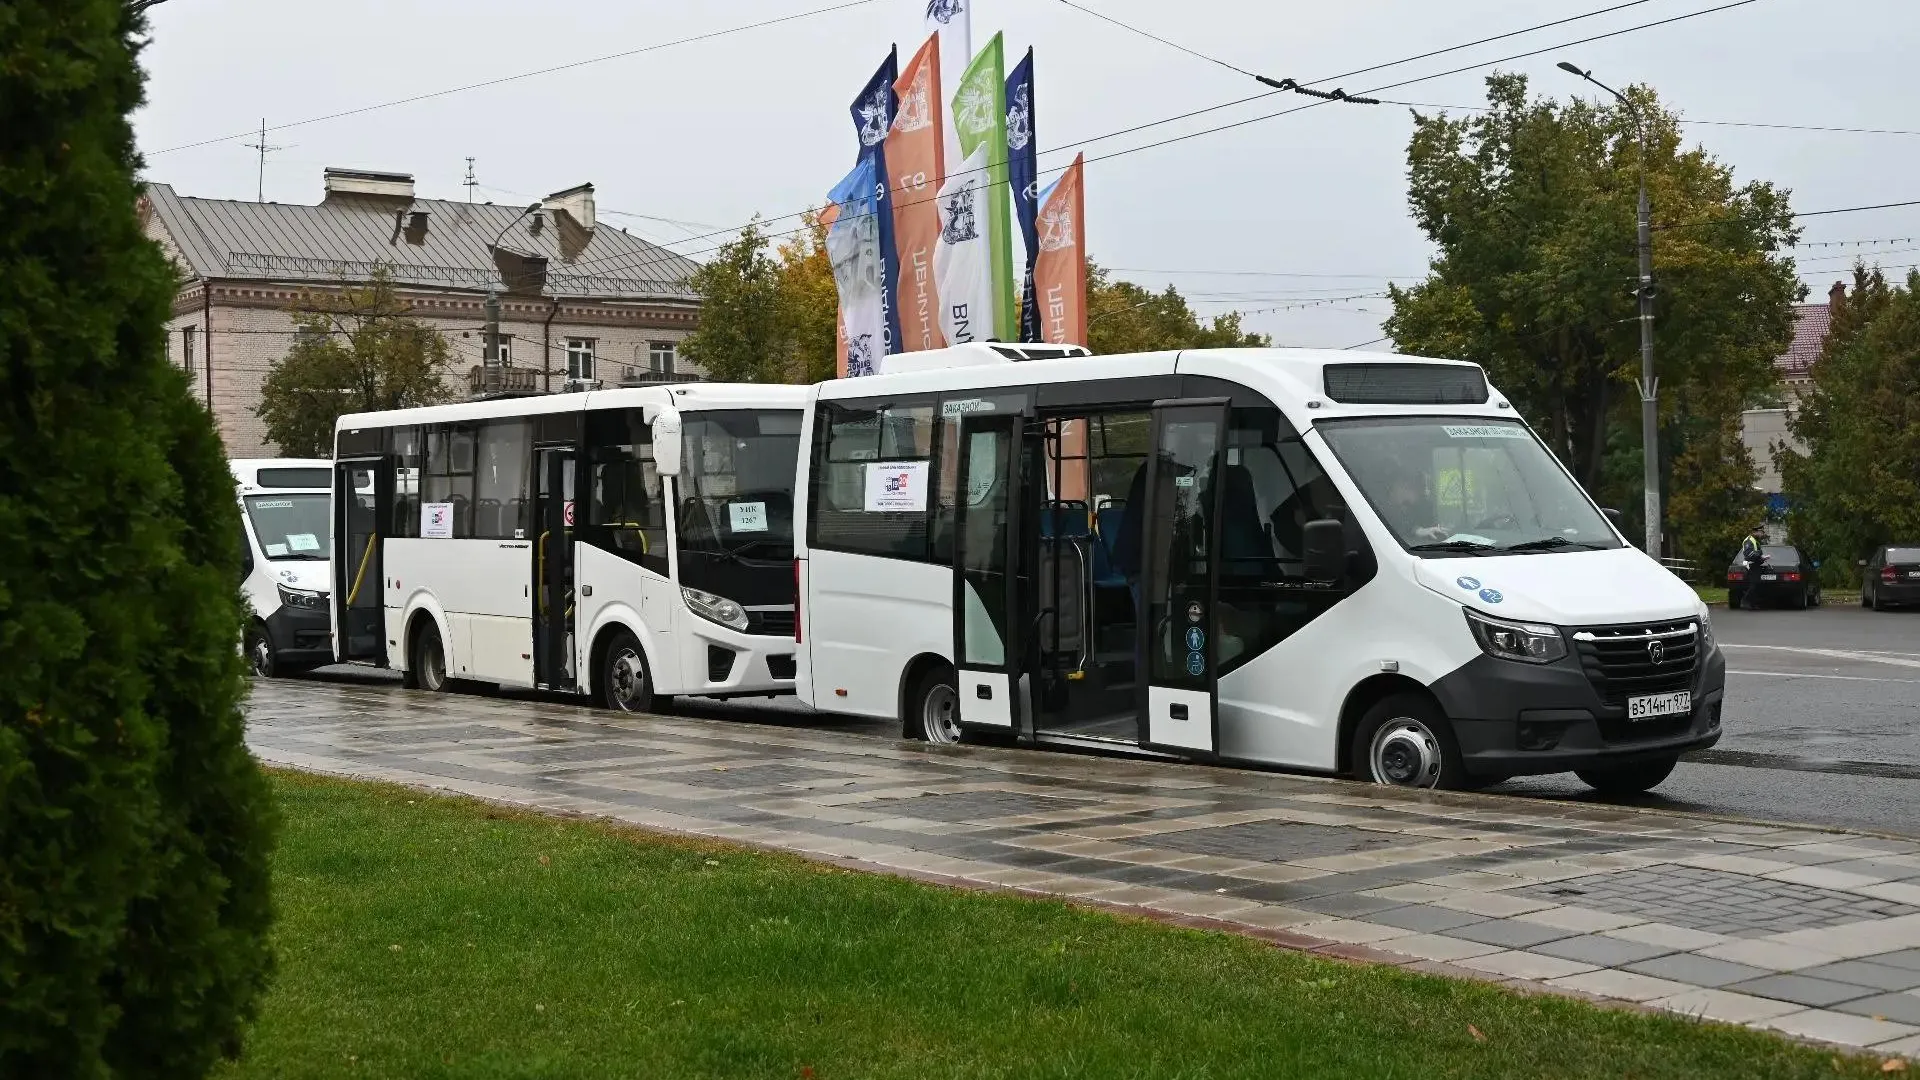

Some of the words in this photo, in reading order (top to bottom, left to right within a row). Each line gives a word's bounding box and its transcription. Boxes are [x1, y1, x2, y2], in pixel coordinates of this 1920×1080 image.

[739, 505, 757, 513] УИК
[1632, 697, 1672, 715] В514НТ
[1674, 693, 1689, 706] 977
